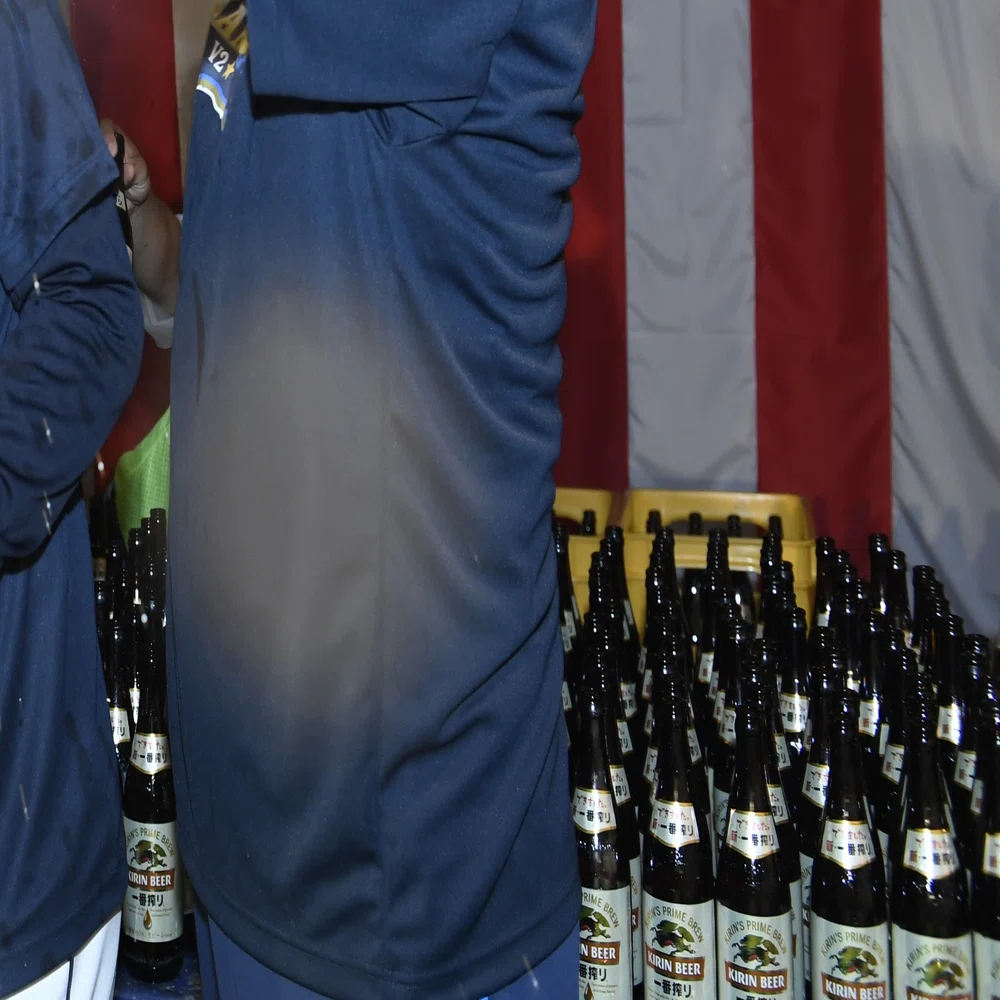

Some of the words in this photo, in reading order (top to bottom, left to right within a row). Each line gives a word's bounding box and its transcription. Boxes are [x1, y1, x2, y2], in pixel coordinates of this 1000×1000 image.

[207, 40, 230, 73] V2
[150, 874, 172, 887] BEER
[132, 893, 164, 907] 一番搾り
[582, 891, 603, 908] RIME
[603, 903, 620, 928] BREW
[662, 905, 686, 922] PRIME
[687, 914, 704, 943] BREW
[724, 920, 745, 944] KIRIN'S
[746, 921, 771, 937] PRIME
[591, 946, 616, 960] BEER
[821, 931, 843, 957] KIRIN'S
[845, 932, 871, 947] PRIME
[647, 950, 672, 973] KIRIN
[675, 961, 701, 976] BEER
[654, 979, 692, 998] 一番搾り
[728, 966, 758, 988] KIRIN
[760, 974, 785, 989] BEER
[825, 979, 857, 1000] KIRIN
[860, 986, 884, 1000] BEER
